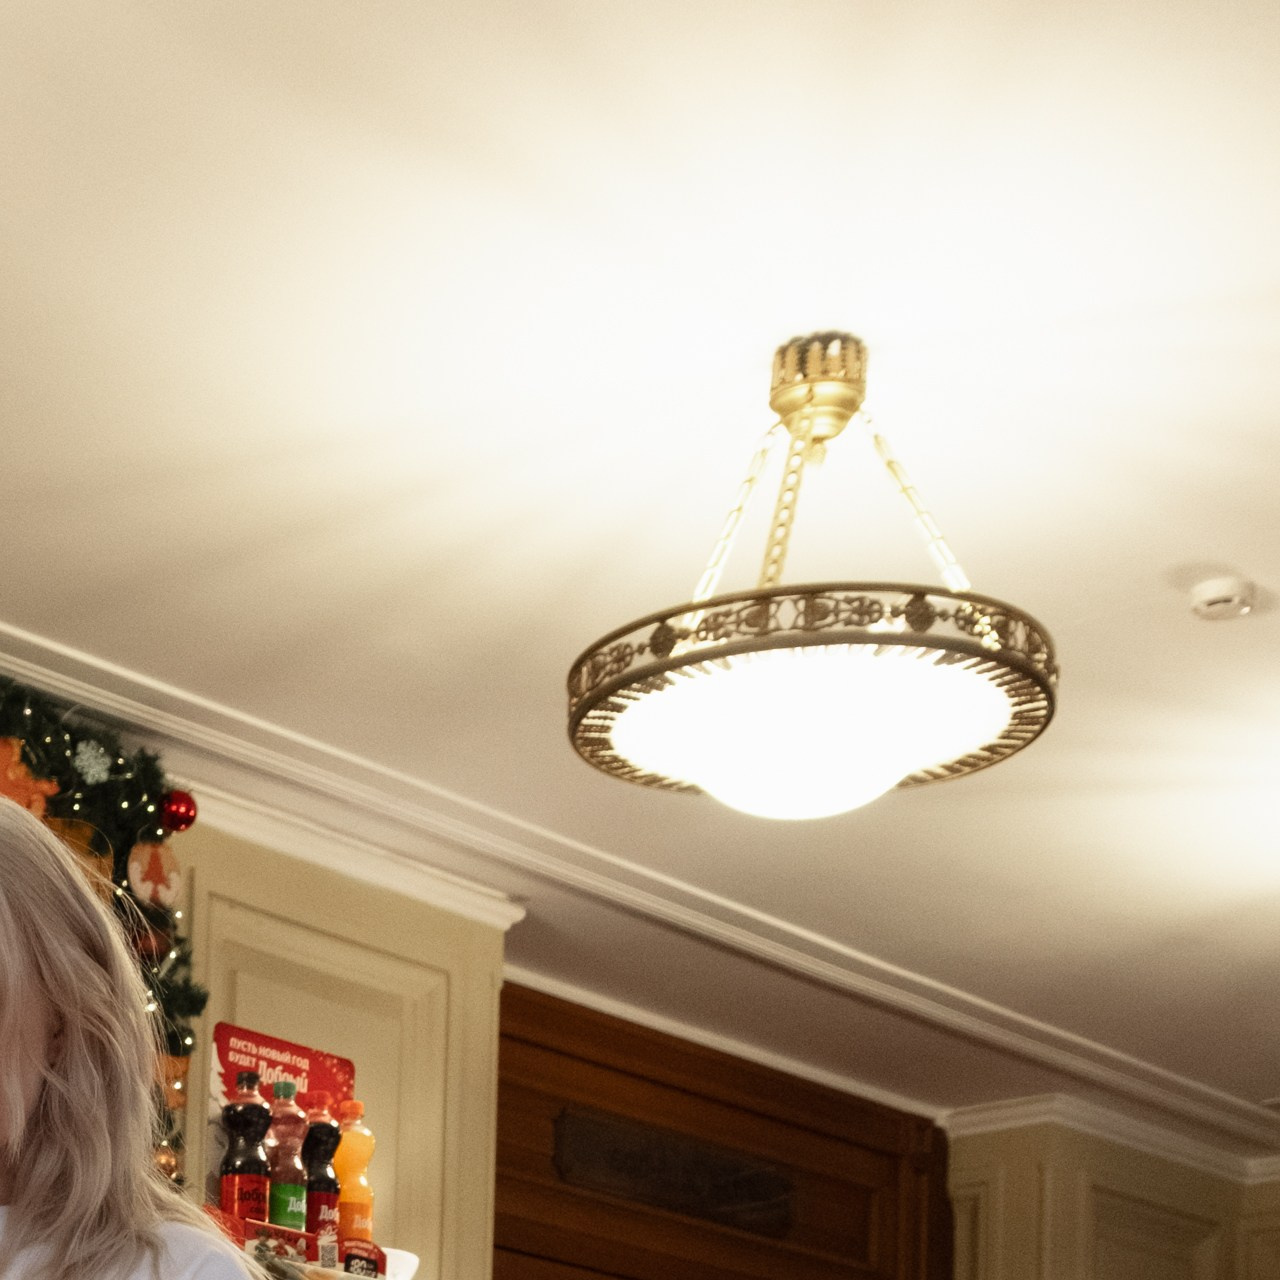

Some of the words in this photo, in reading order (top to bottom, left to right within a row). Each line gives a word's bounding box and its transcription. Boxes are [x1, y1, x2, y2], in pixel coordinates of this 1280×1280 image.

[228, 1050, 257, 1068] БУДЕТ
[229, 1037, 258, 1054] ПУСТЬ
[259, 1045, 291, 1064] НОВЫЙ
[291, 1055, 310, 1070] ГОД
